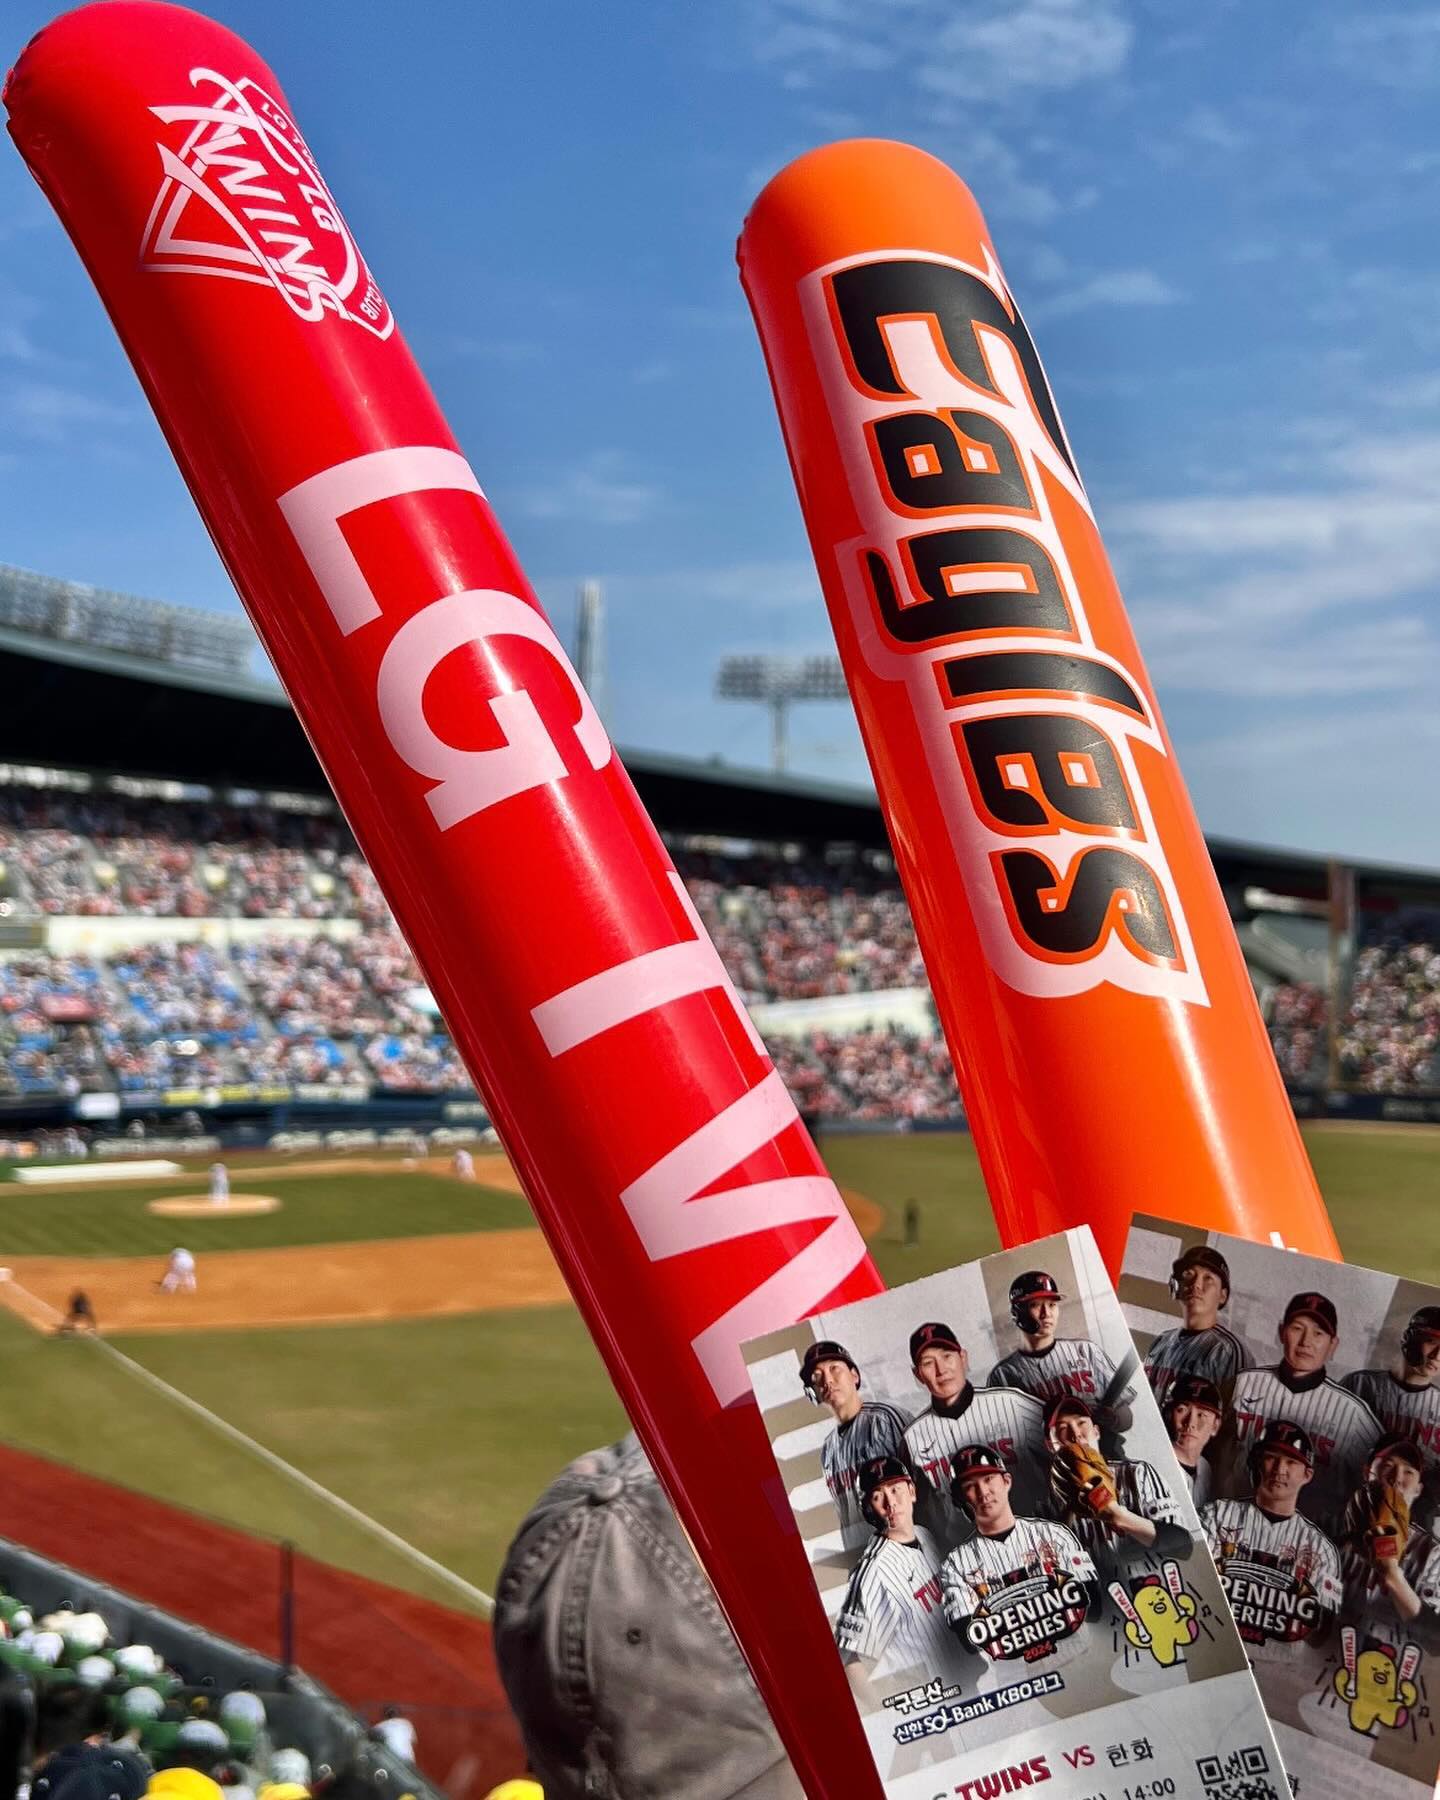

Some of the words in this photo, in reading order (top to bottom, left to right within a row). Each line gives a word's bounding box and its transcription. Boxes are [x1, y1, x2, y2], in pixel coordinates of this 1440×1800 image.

[298, 183, 341, 234] LG
[278, 446, 612, 832] LG
[820, 255, 1190, 975] Eagles
[968, 1581, 1081, 1645] OPENING
[1218, 1575, 1316, 1619] PENING
[1231, 1602, 1287, 1633] ERIES
[1001, 1612, 1066, 1655] SERIES
[896, 1721, 923, 1744] 신한
[952, 1697, 995, 1722] Bank
[954, 1755, 1051, 1800] TWINS
[1062, 1745, 1096, 1769] VS
[1106, 1737, 1154, 1768] 한화
[1123, 1777, 1176, 1800] 14:00
